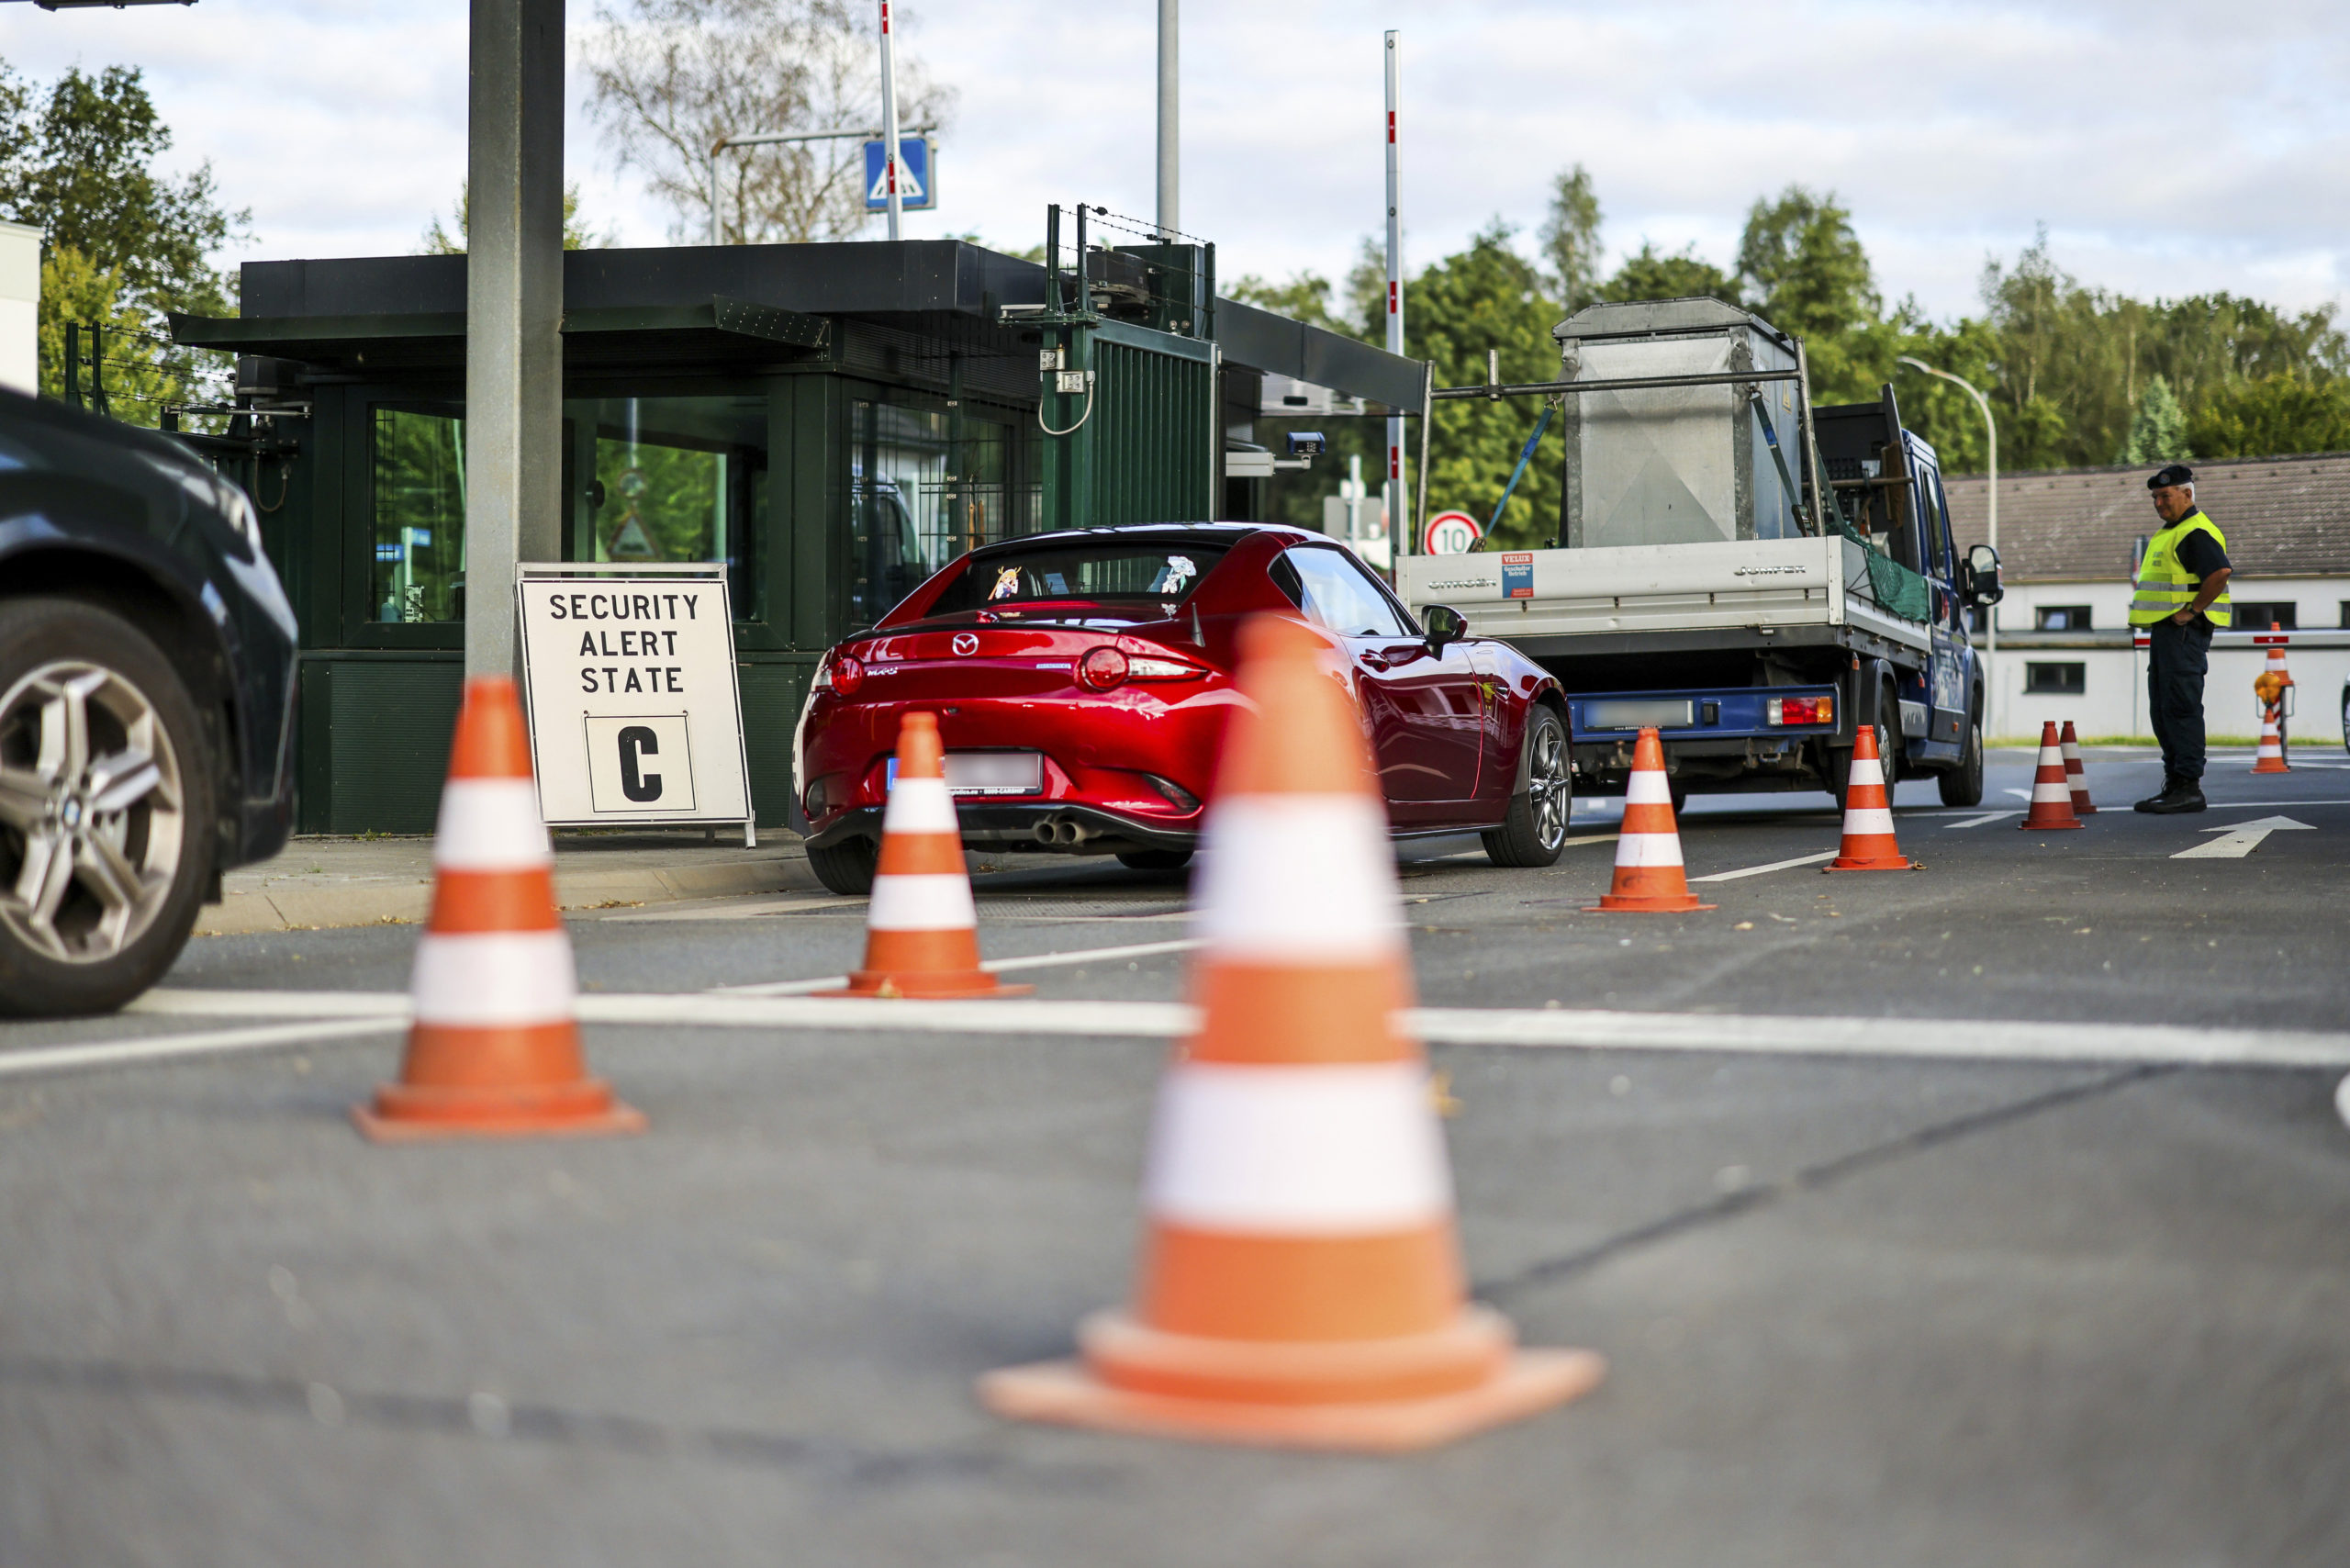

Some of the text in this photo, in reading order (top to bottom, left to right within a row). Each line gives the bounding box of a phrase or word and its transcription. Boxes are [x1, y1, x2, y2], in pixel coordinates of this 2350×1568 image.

[1442, 528, 1467, 553] 10
[1504, 554, 1530, 563] VELUX
[1428, 578, 1497, 589] CITROËN
[1733, 566, 1806, 577] JUMPER
[550, 594, 699, 620] SECURITY
[579, 631, 677, 656] ALERT
[580, 666, 684, 693] STATE
[617, 725, 663, 802] C
